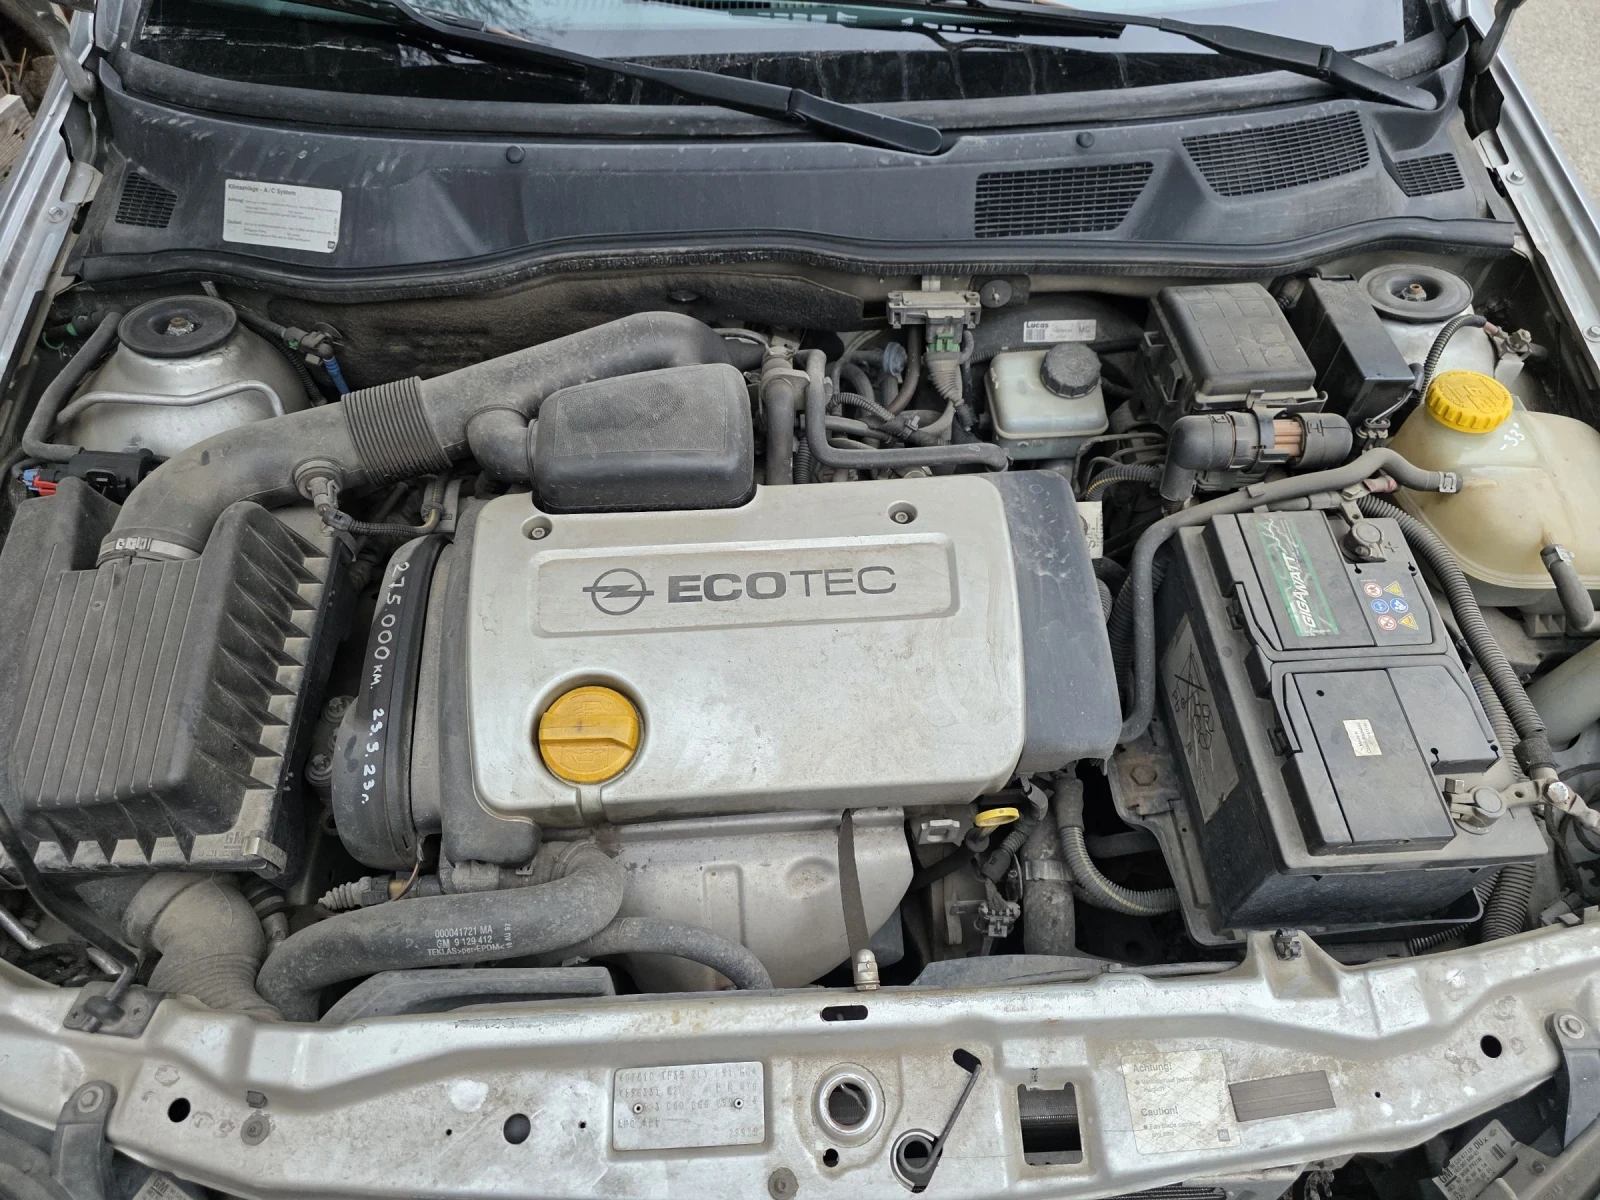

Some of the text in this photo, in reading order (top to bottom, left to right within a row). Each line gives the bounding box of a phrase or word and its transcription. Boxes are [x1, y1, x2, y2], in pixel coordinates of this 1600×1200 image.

[668, 565, 897, 604] ECOTEC
[1282, 553, 1316, 628] GIGAWATT
[435, 925, 493, 938] 000041721 MA
[437, 939, 450, 948] GM
[479, 935, 492, 944] 412
[1133, 1062, 1172, 1072] Achtung!
[1141, 1106, 1178, 1116] Caution!
[1474, 1138, 1484, 1149] DU
[152, 1178, 170, 1194] GM
